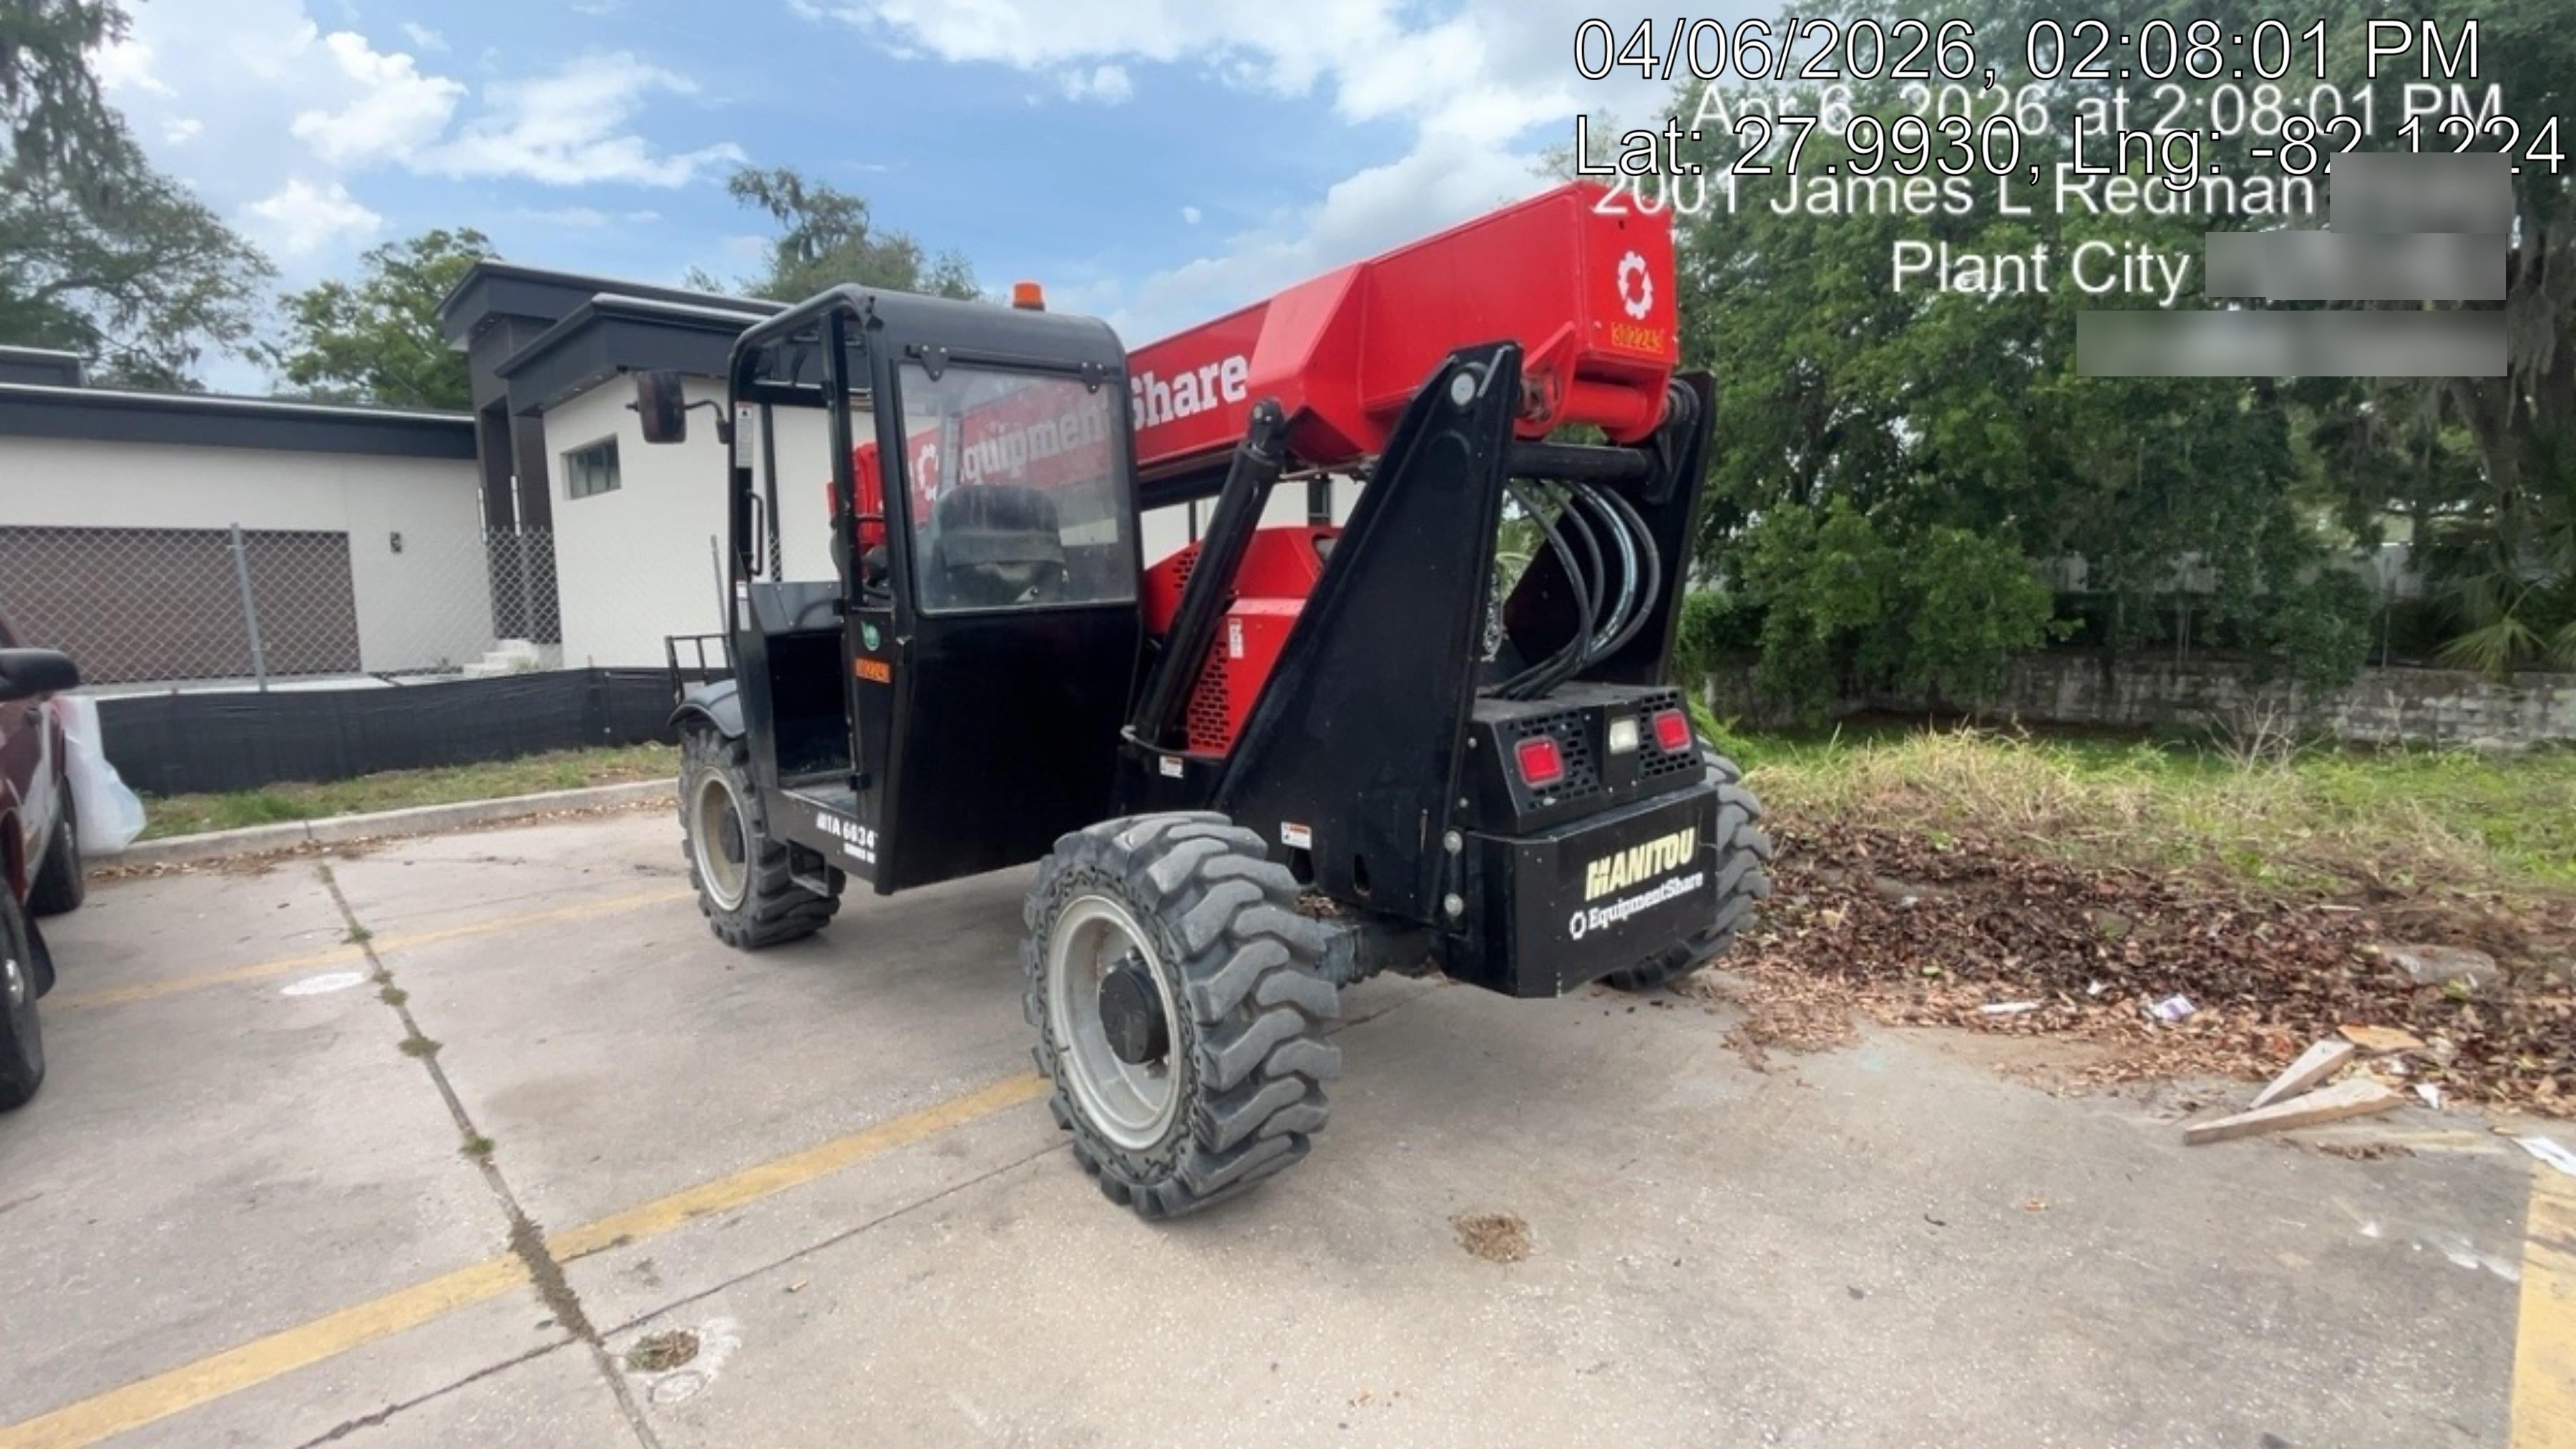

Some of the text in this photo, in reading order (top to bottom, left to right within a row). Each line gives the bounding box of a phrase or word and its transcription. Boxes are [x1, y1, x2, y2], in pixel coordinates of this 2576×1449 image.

[959, 355, 1249, 488] quipmenthare
[1585, 826, 1695, 902] MANITOU
[1588, 872, 1704, 930] EquipmentShare
